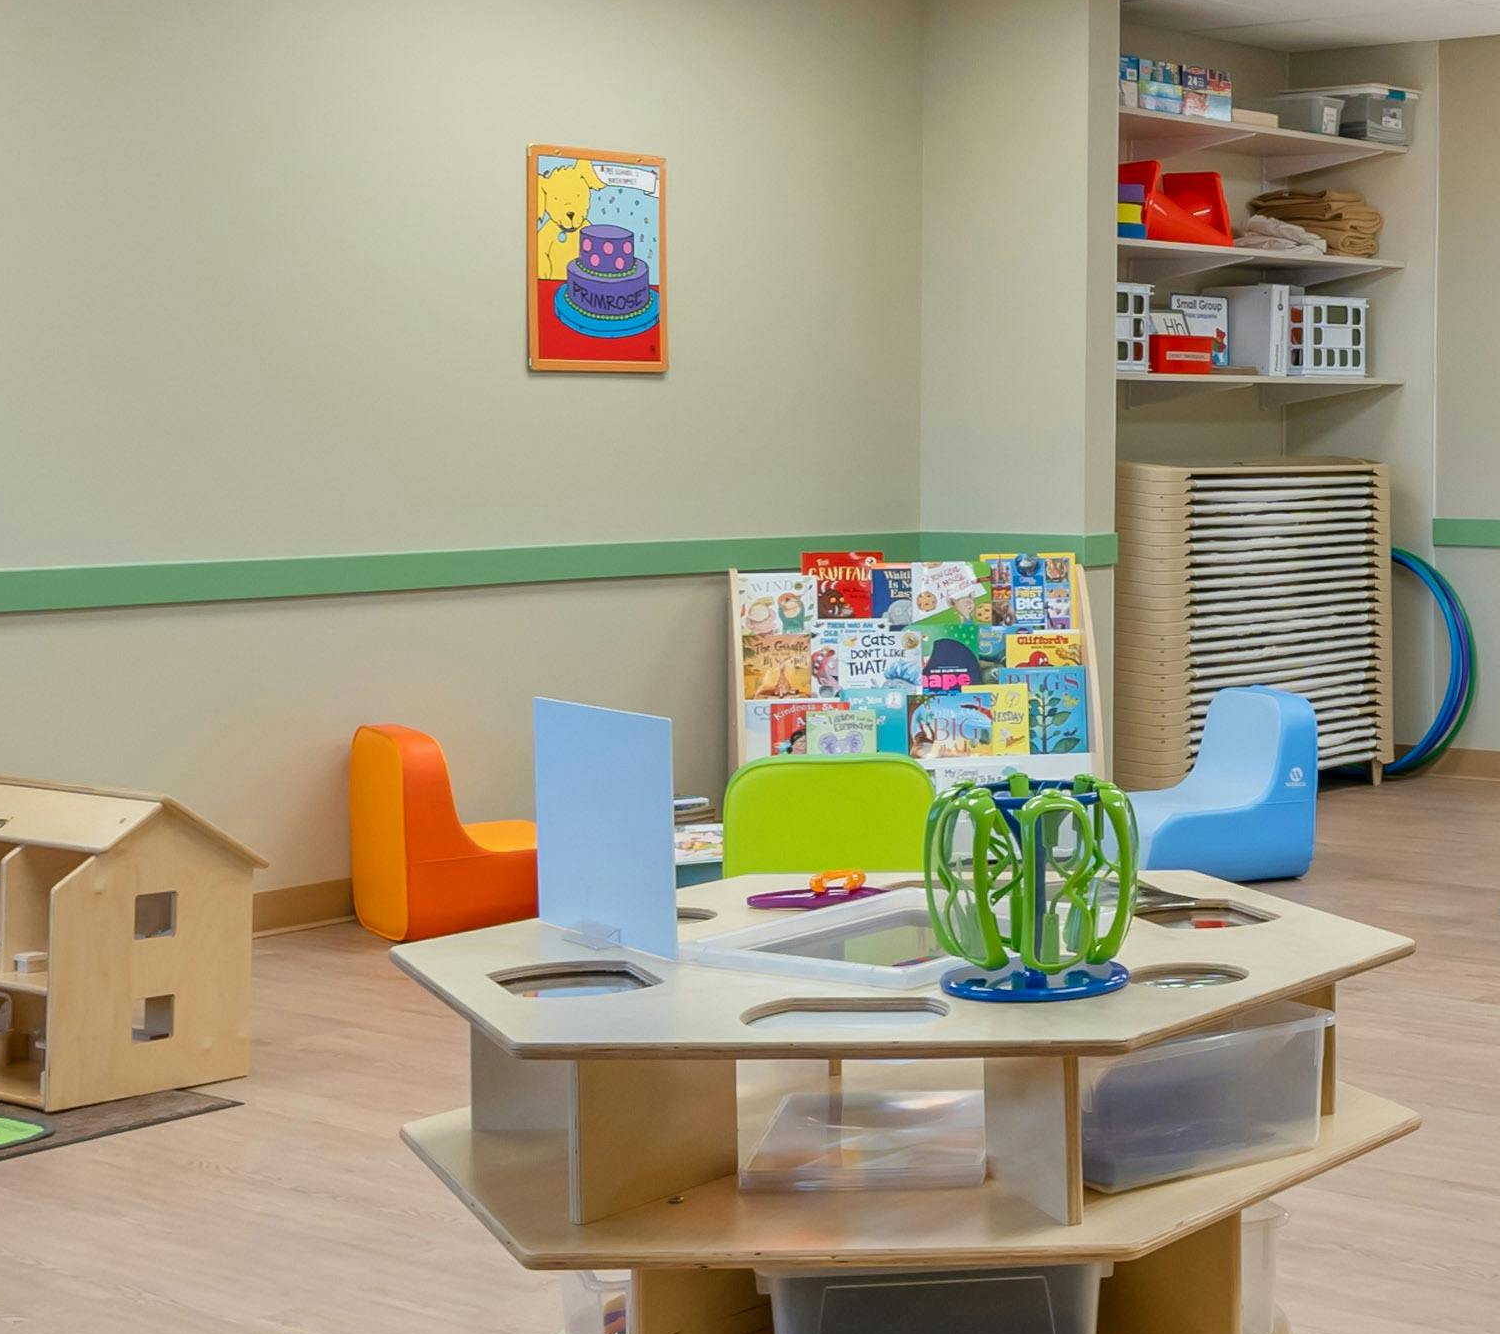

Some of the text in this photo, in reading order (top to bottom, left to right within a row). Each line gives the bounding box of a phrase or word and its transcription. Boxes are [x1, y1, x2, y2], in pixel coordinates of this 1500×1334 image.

[1187, 75, 1198, 87] 24
[573, 281, 642, 311] PRIMROSE
[1176, 299, 1222, 312] Small Group
[1163, 318, 1185, 336] Hh
[1015, 598, 1044, 610] BIG
[861, 634, 895, 648] Cats
[1017, 636, 1068, 645] Clifford's
[754, 643, 771, 654] The
[850, 648, 906, 659] DON'T LIKE
[847, 660, 887, 676] THAT!
[774, 704, 816, 721] Kindness
[935, 718, 978, 741] BIG
